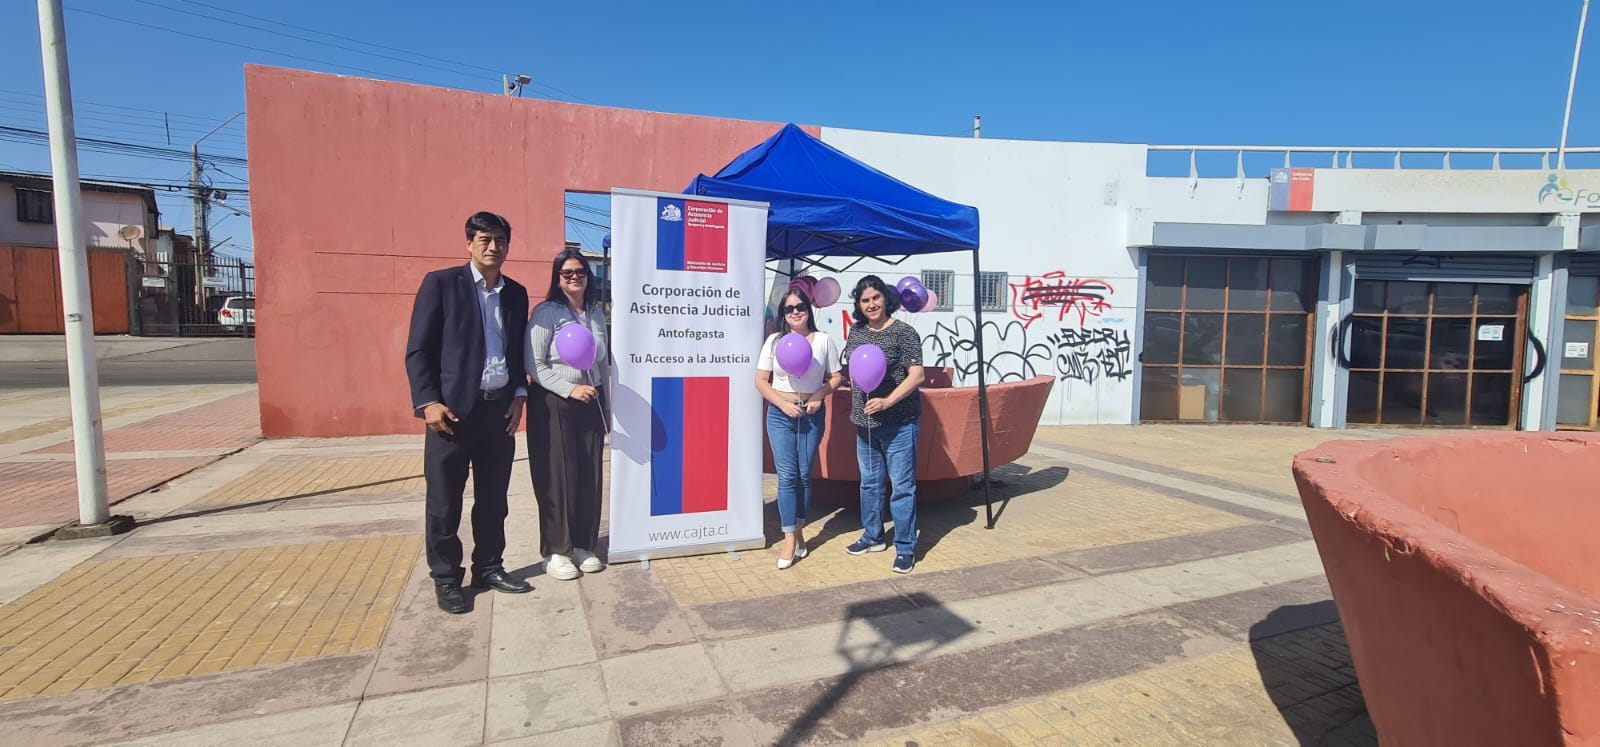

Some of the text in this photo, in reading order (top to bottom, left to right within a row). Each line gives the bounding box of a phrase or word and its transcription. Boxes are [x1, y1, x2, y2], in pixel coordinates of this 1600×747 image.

[687, 205, 717, 213] Corporación
[642, 283, 741, 299] Corporación de
[629, 302, 751, 317] Asistencia Judicial
[658, 328, 725, 341] Antofagasta
[630, 353, 750, 364] Tu Acceso a la Justicia
[648, 523, 729, 543] www.cajta.cl
